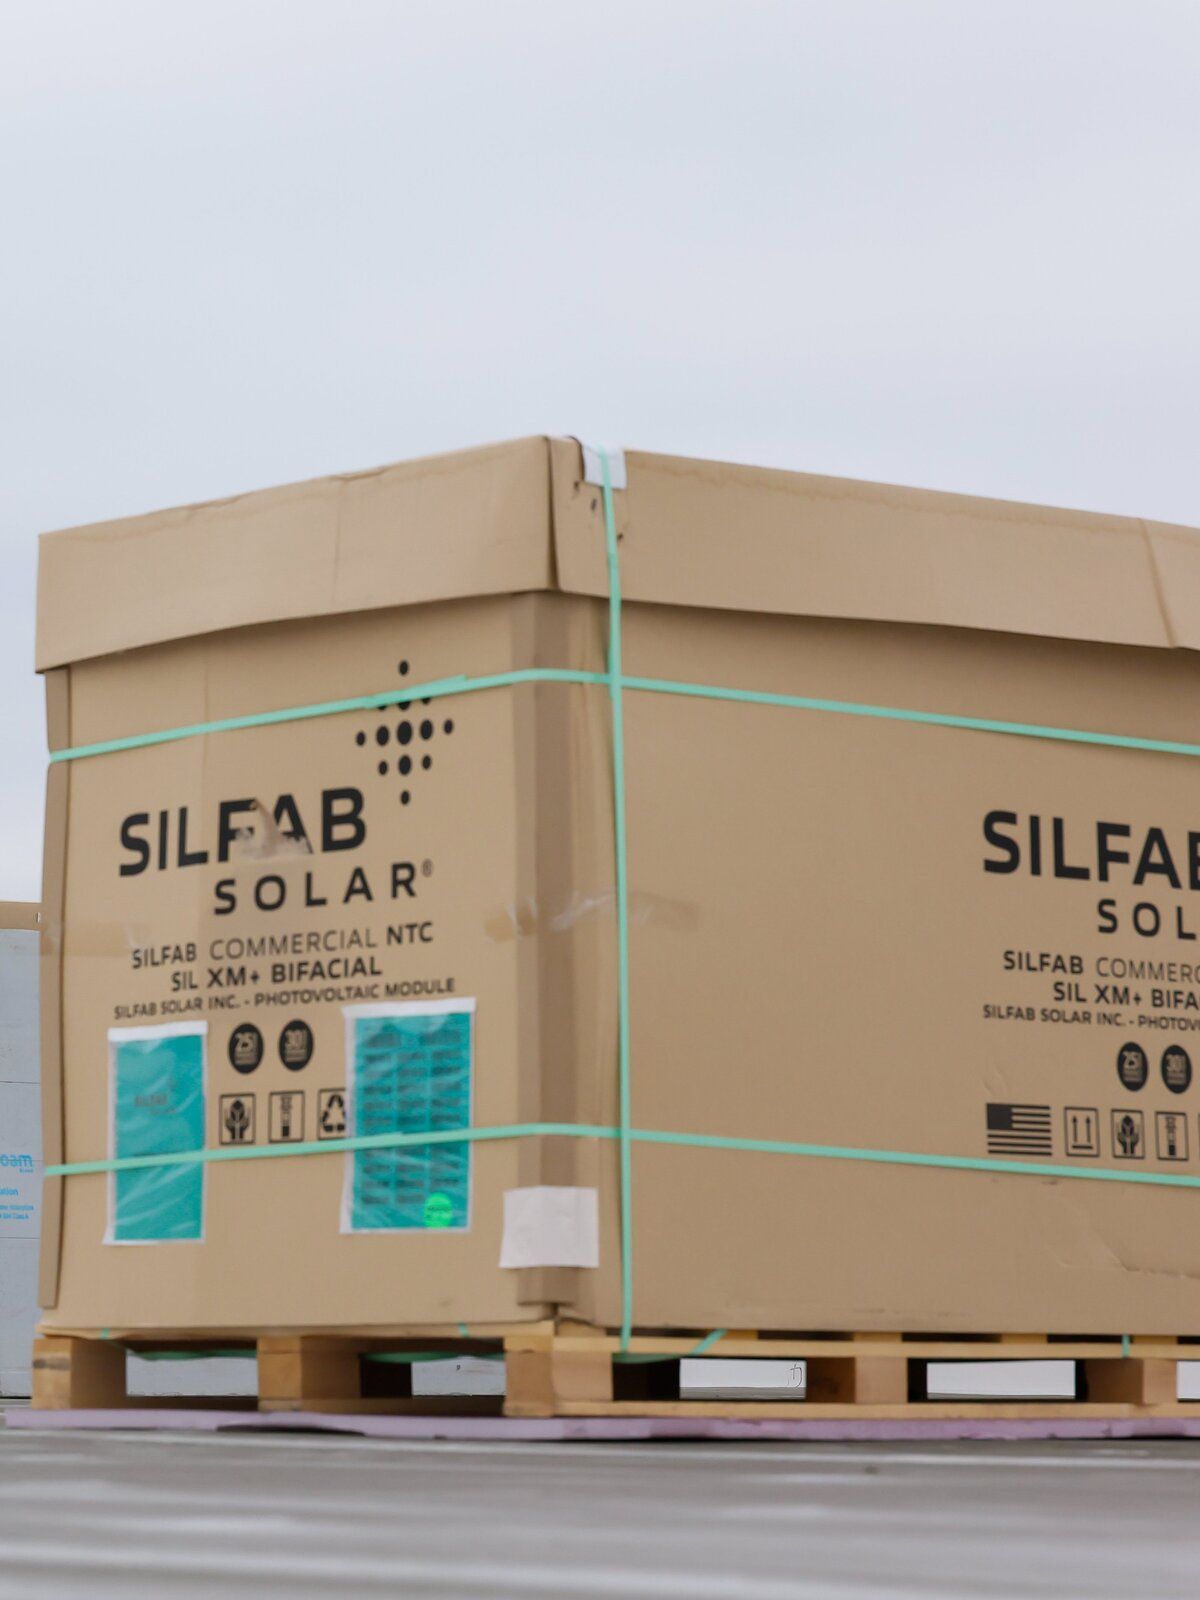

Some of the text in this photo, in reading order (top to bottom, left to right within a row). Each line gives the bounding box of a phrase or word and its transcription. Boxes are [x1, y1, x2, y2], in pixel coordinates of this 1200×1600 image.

[119, 786, 366, 878] SILFAB
[1097, 898, 1197, 941] SOL
[132, 921, 433, 969] SILFAB COMMERCIAL NTC
[171, 956, 382, 992] SIL XM+ BIFACIAL
[1003, 950, 1200, 984] SILFAB COMMER
[114, 1002, 157, 1020] SILFAB
[161, 997, 203, 1015] SOLAR
[208, 994, 240, 1010] INC.
[254, 984, 379, 1006] PHOTOVOLTAIC
[385, 978, 455, 997] MODULE
[1053, 981, 1200, 1010] SIL XM+ BIFA
[983, 1004, 1035, 1021] SILFAB
[1040, 1008, 1091, 1024] SOLAR
[1096, 1012, 1126, 1027] INC.
[1138, 1015, 1200, 1032] PHOTOV
